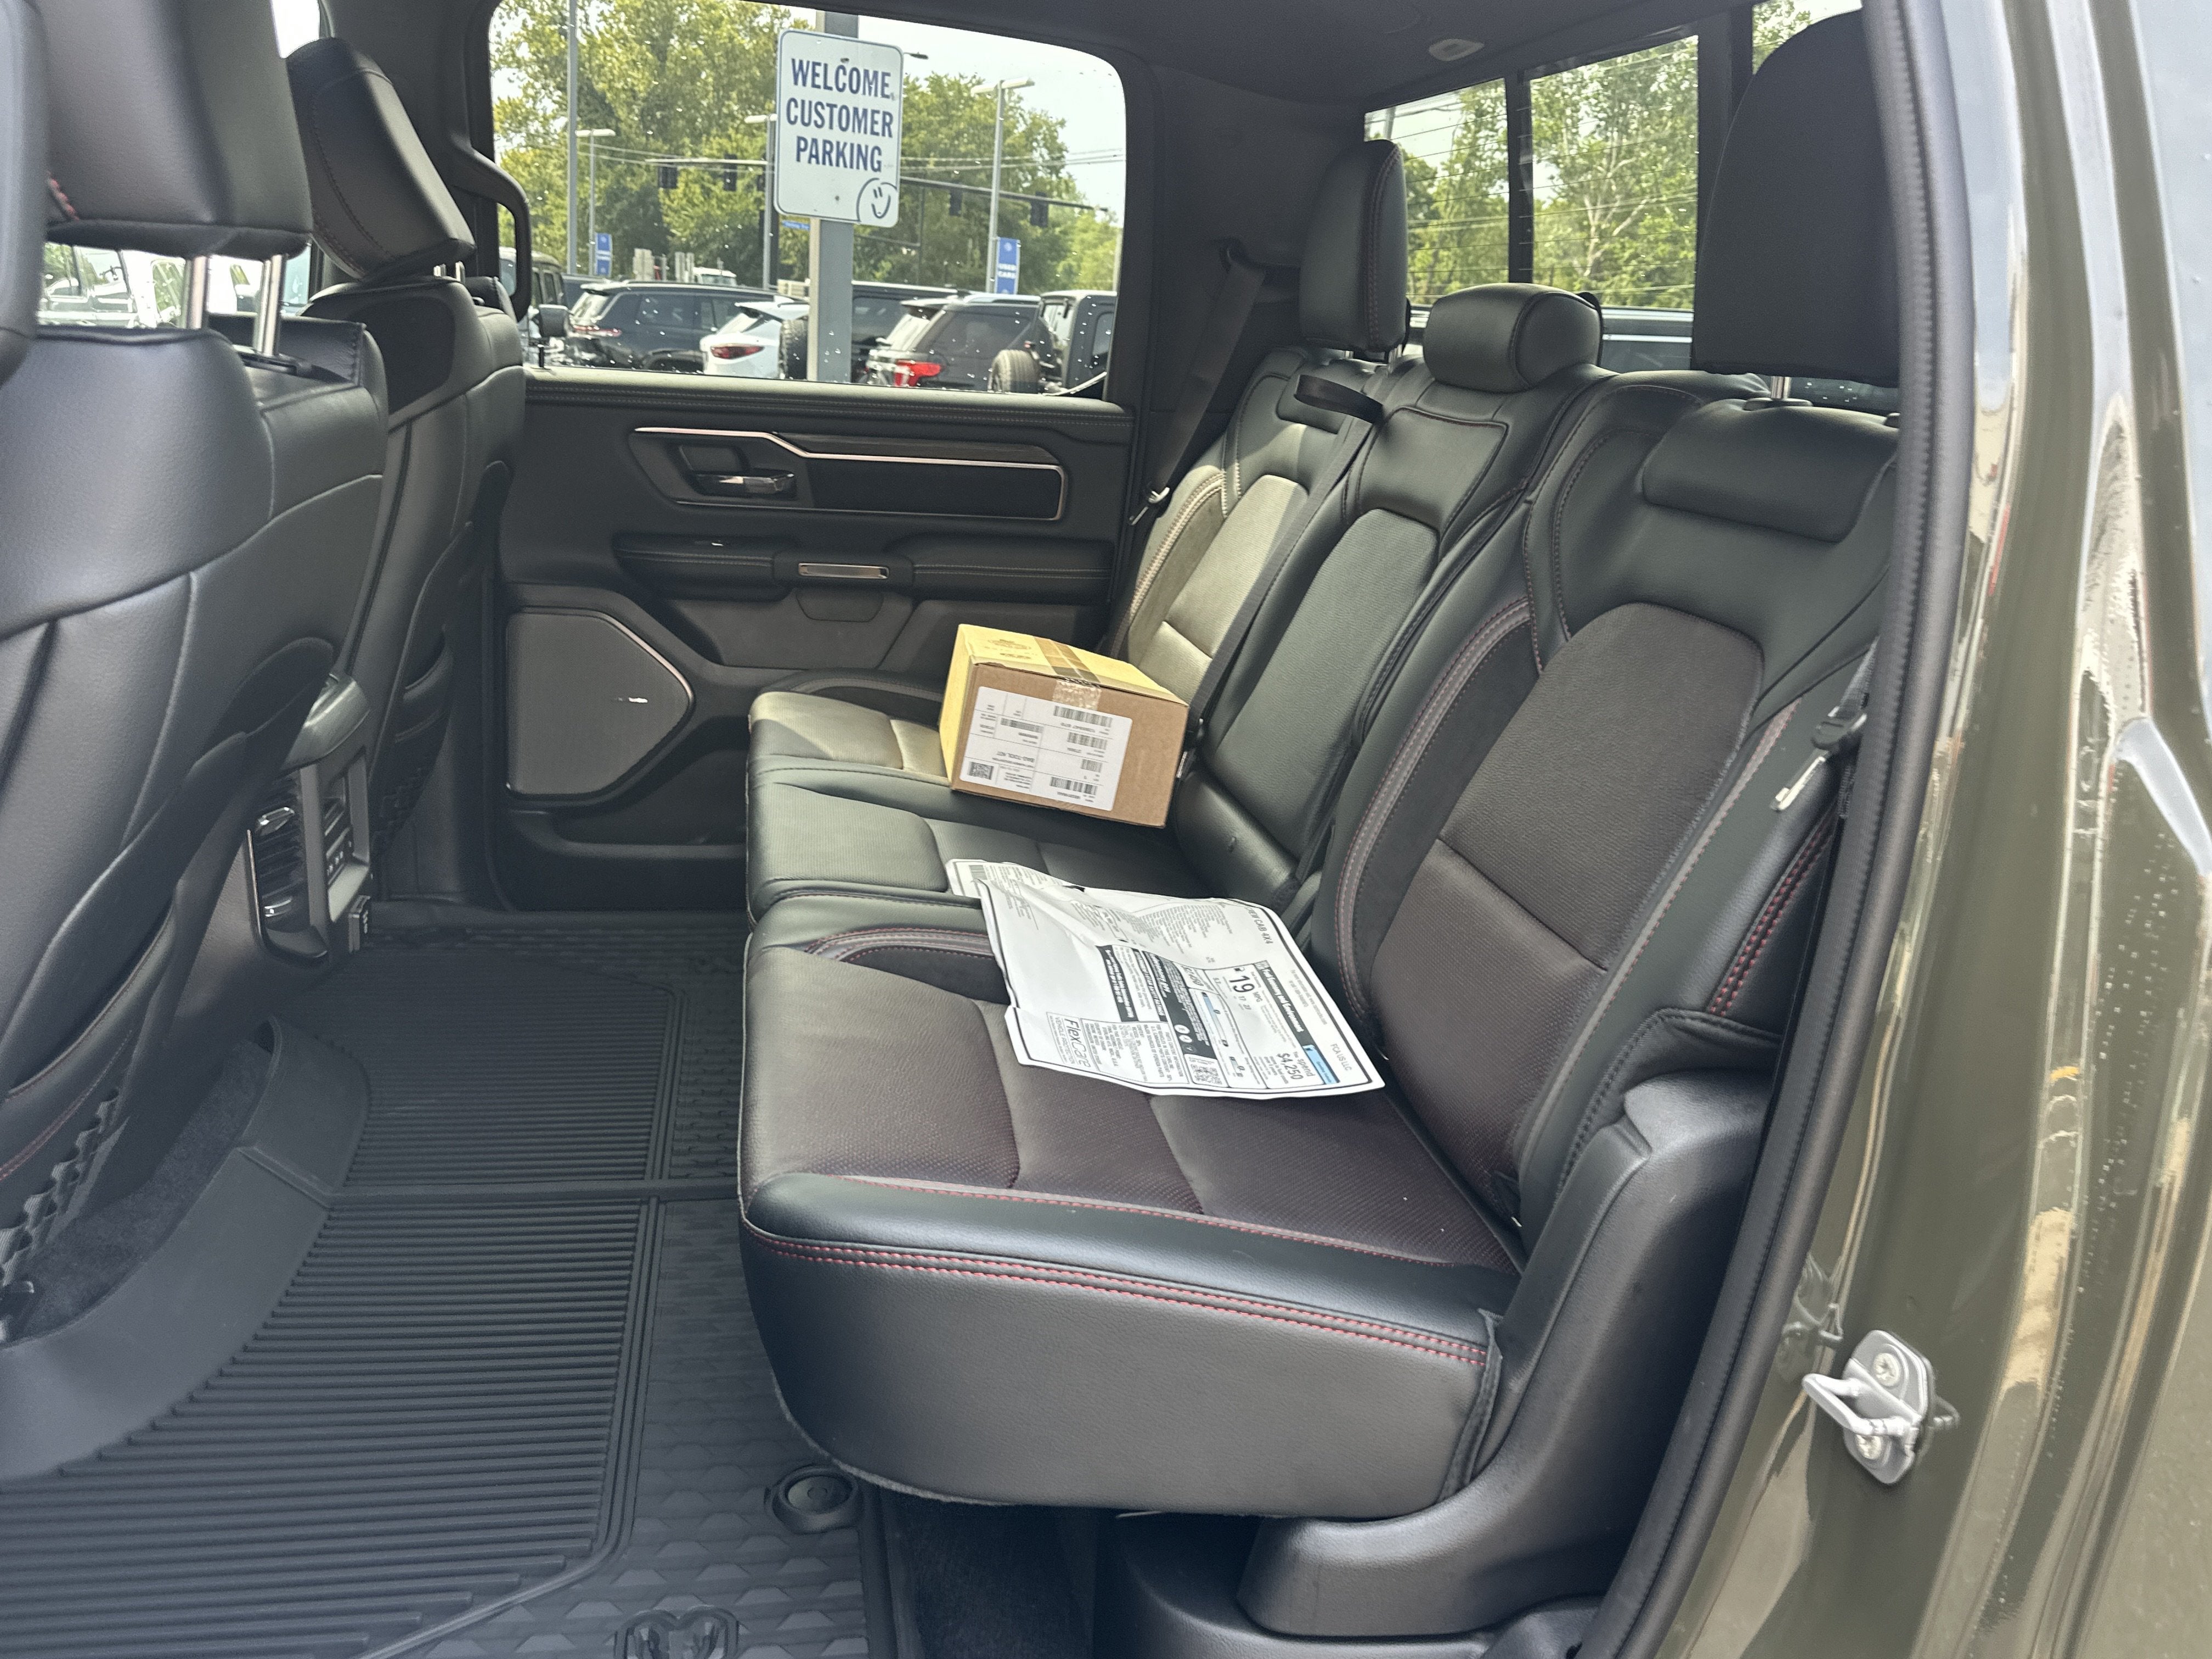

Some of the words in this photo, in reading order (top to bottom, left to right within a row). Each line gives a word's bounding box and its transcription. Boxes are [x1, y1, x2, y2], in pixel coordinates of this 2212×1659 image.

[791, 58, 891, 99] WELCOME
[786, 98, 894, 138] CUSTOMER
[796, 136, 882, 173] PARKING
[1254, 919, 1266, 931] CAB
[1261, 933, 1273, 944] 4X4
[1229, 975, 1255, 992] 19
[1262, 969, 1273, 977] Fuel
[1267, 977, 1282, 995] Economy
[1252, 991, 1262, 1002] MPG
[1283, 1003, 1304, 1032] Environment
[1063, 1019, 1090, 1066] FlexCare
[1277, 1053, 1303, 1079] $4,250
[1297, 1059, 1315, 1076] spend
[1330, 1043, 1341, 1053] FCA
[1341, 1061, 1352, 1071] LLC
